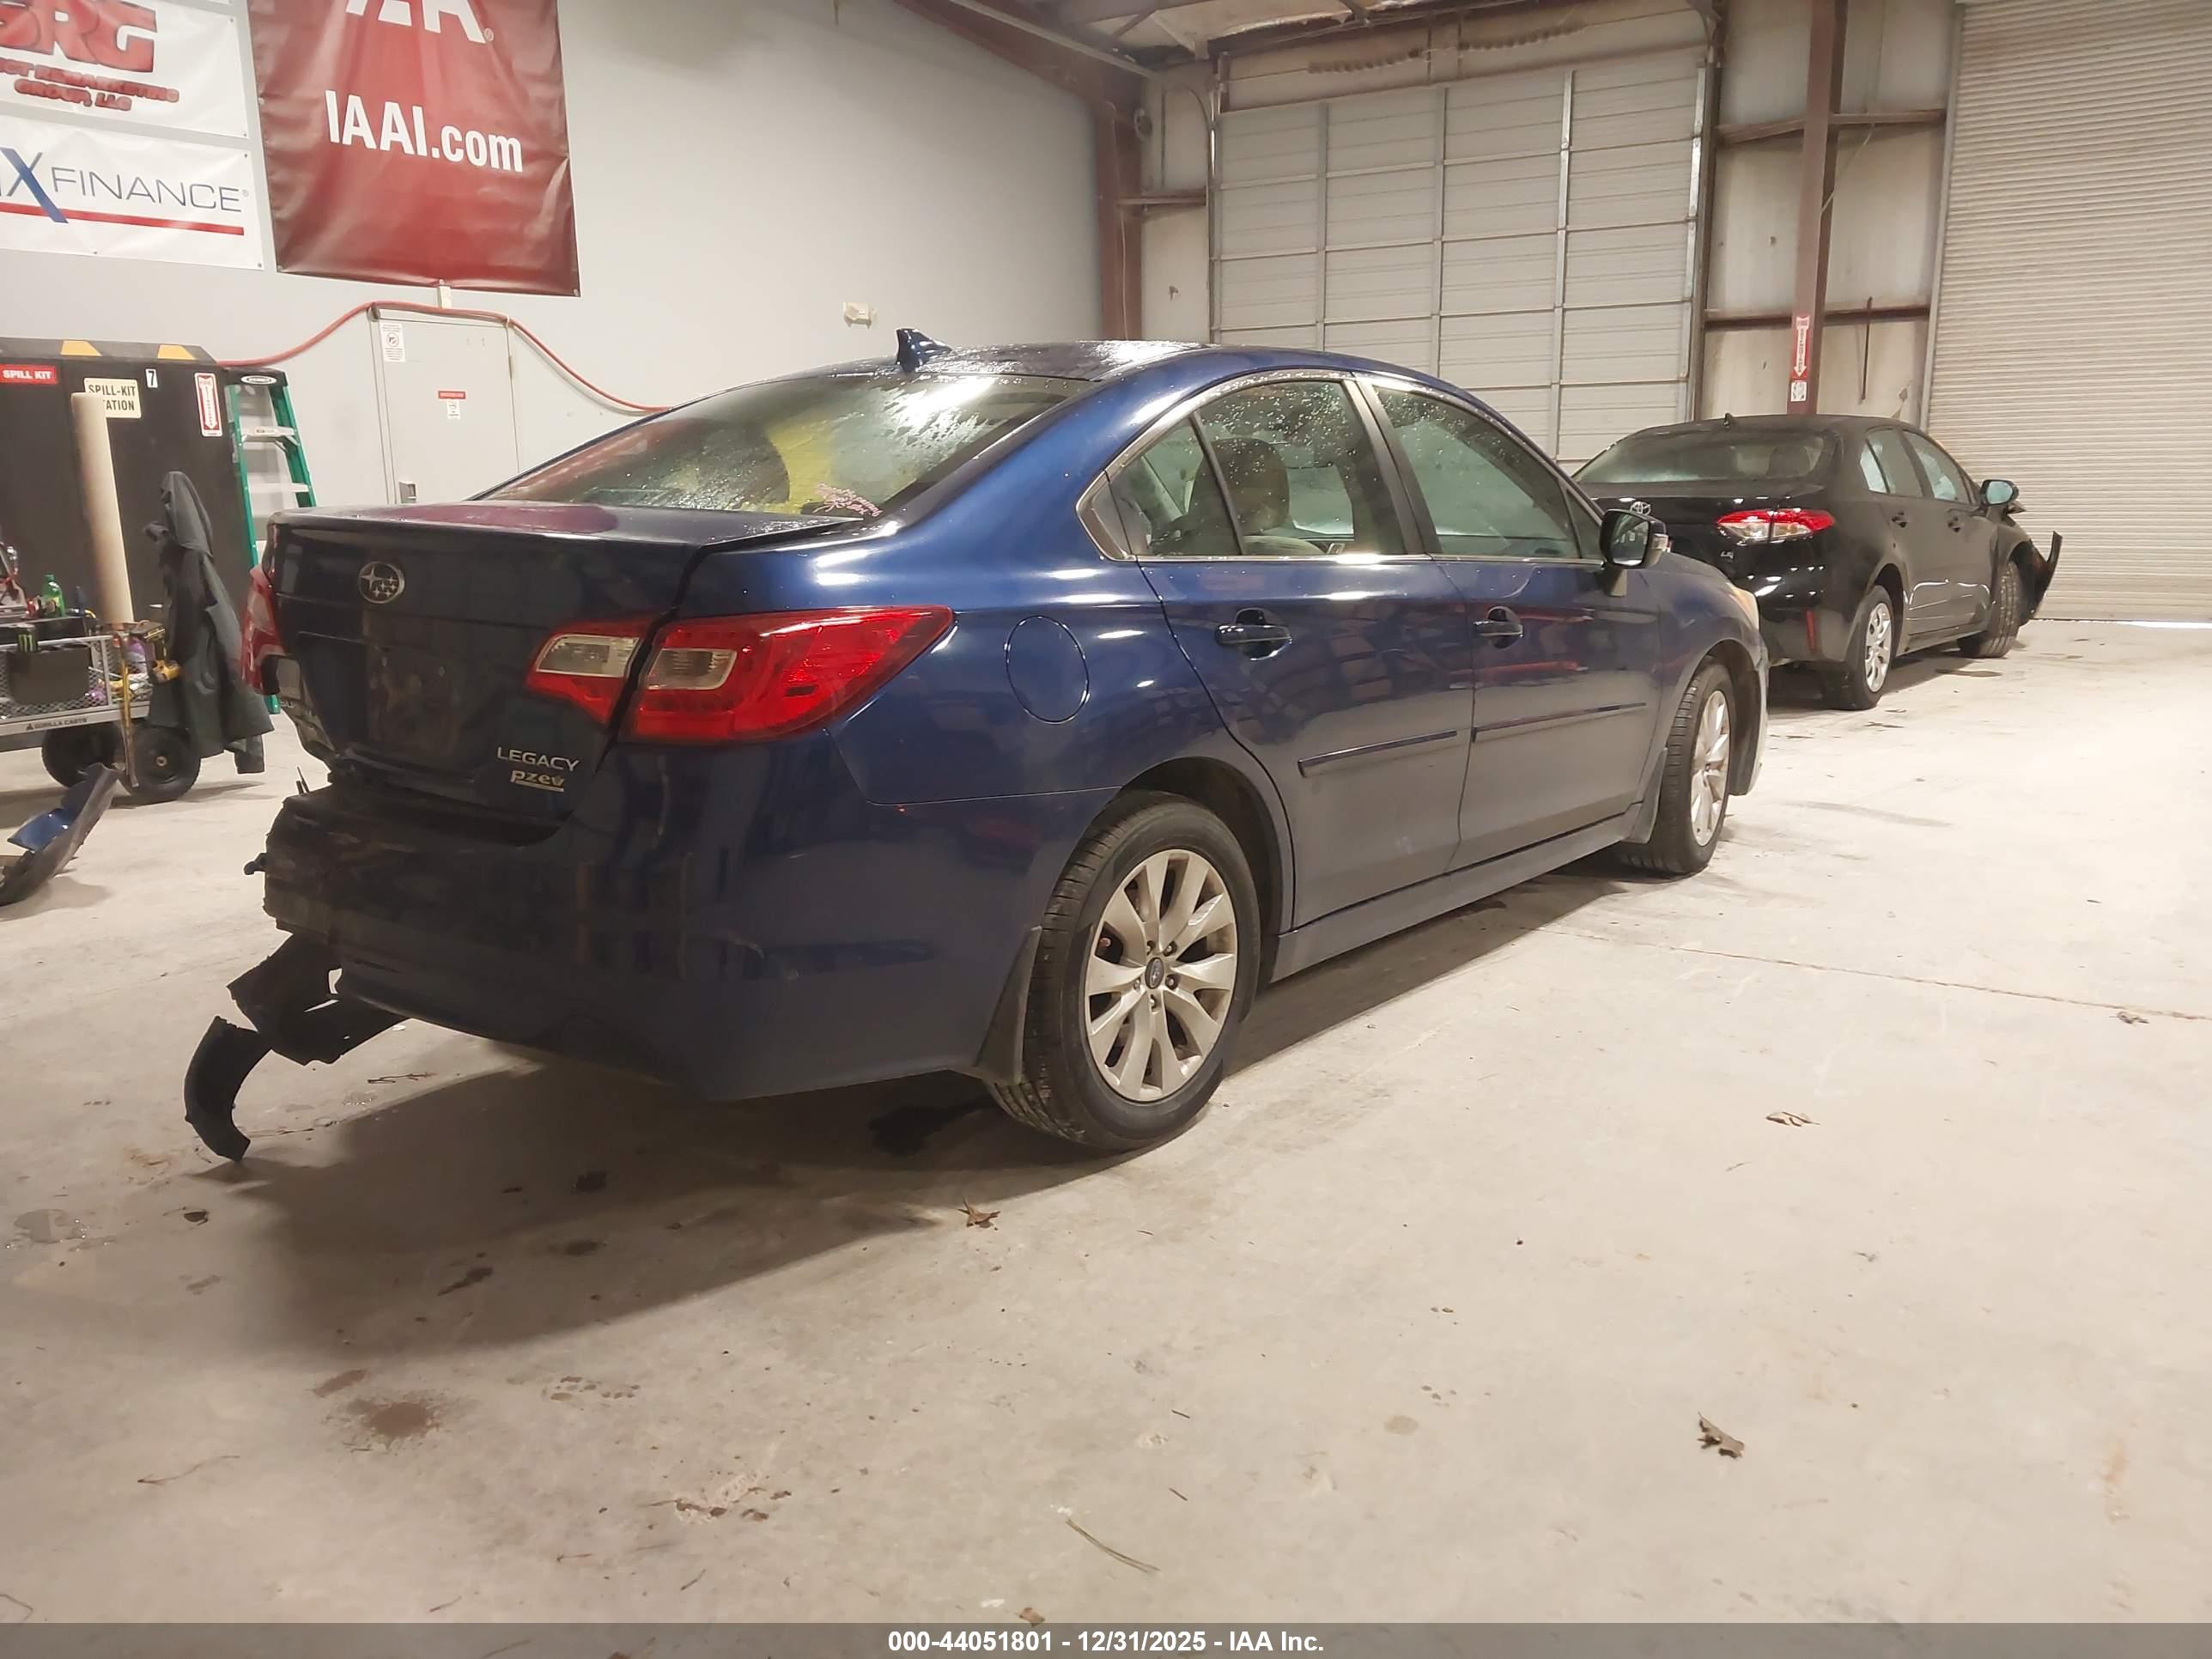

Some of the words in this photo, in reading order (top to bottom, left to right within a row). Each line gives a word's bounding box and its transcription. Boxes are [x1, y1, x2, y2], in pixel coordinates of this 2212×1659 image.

[325, 89, 523, 173] IAAI.com
[3, 369, 33, 380] SPILL
[34, 370, 52, 380] KIT
[148, 370, 155, 386] 7
[88, 384, 136, 397] SPILL-KIT
[103, 399, 135, 411] ATION
[496, 746, 580, 772] LEGACY
